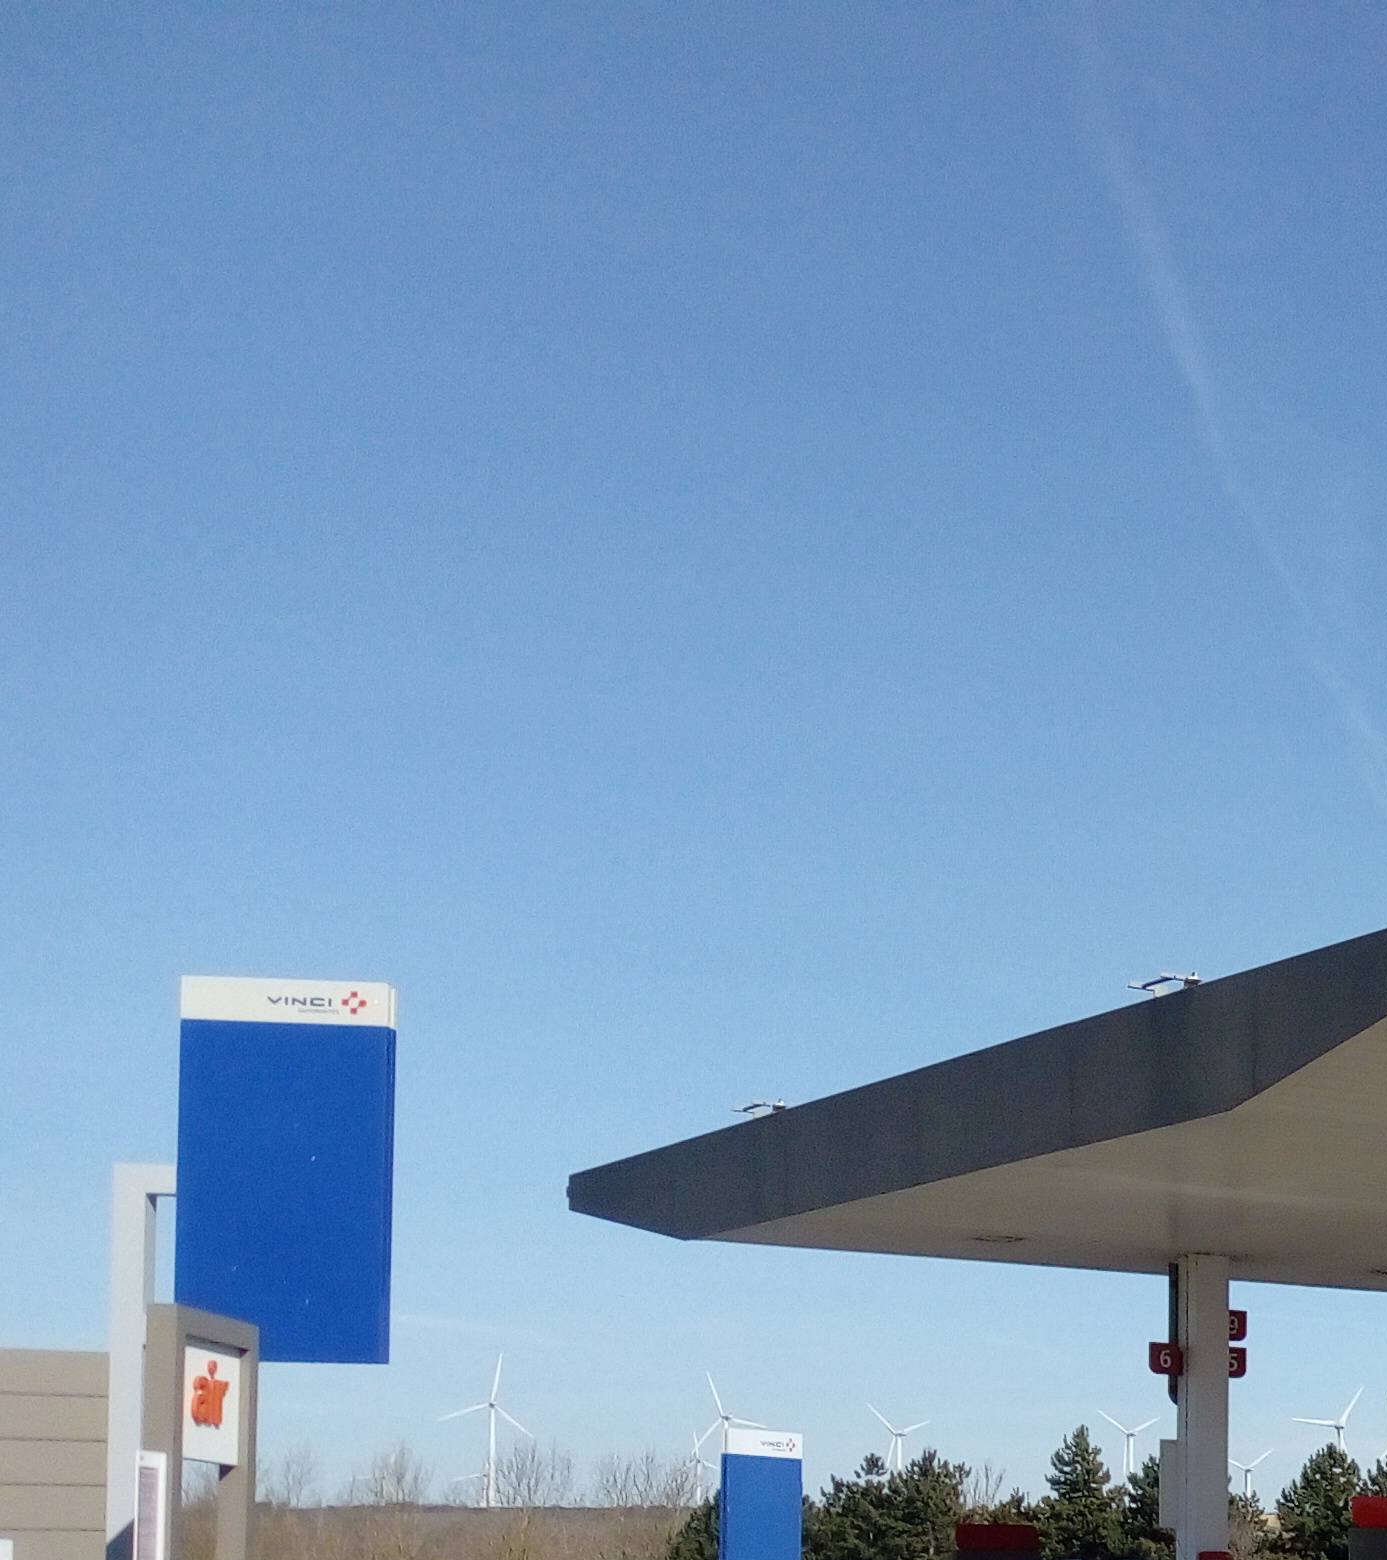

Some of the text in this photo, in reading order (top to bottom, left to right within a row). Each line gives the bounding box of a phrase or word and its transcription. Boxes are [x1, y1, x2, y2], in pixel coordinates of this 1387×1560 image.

[267, 996, 332, 1007] VINCI
[1160, 1350, 1172, 1368] 6
[1229, 1353, 1238, 1371] 5
[191, 1360, 229, 1429] air
